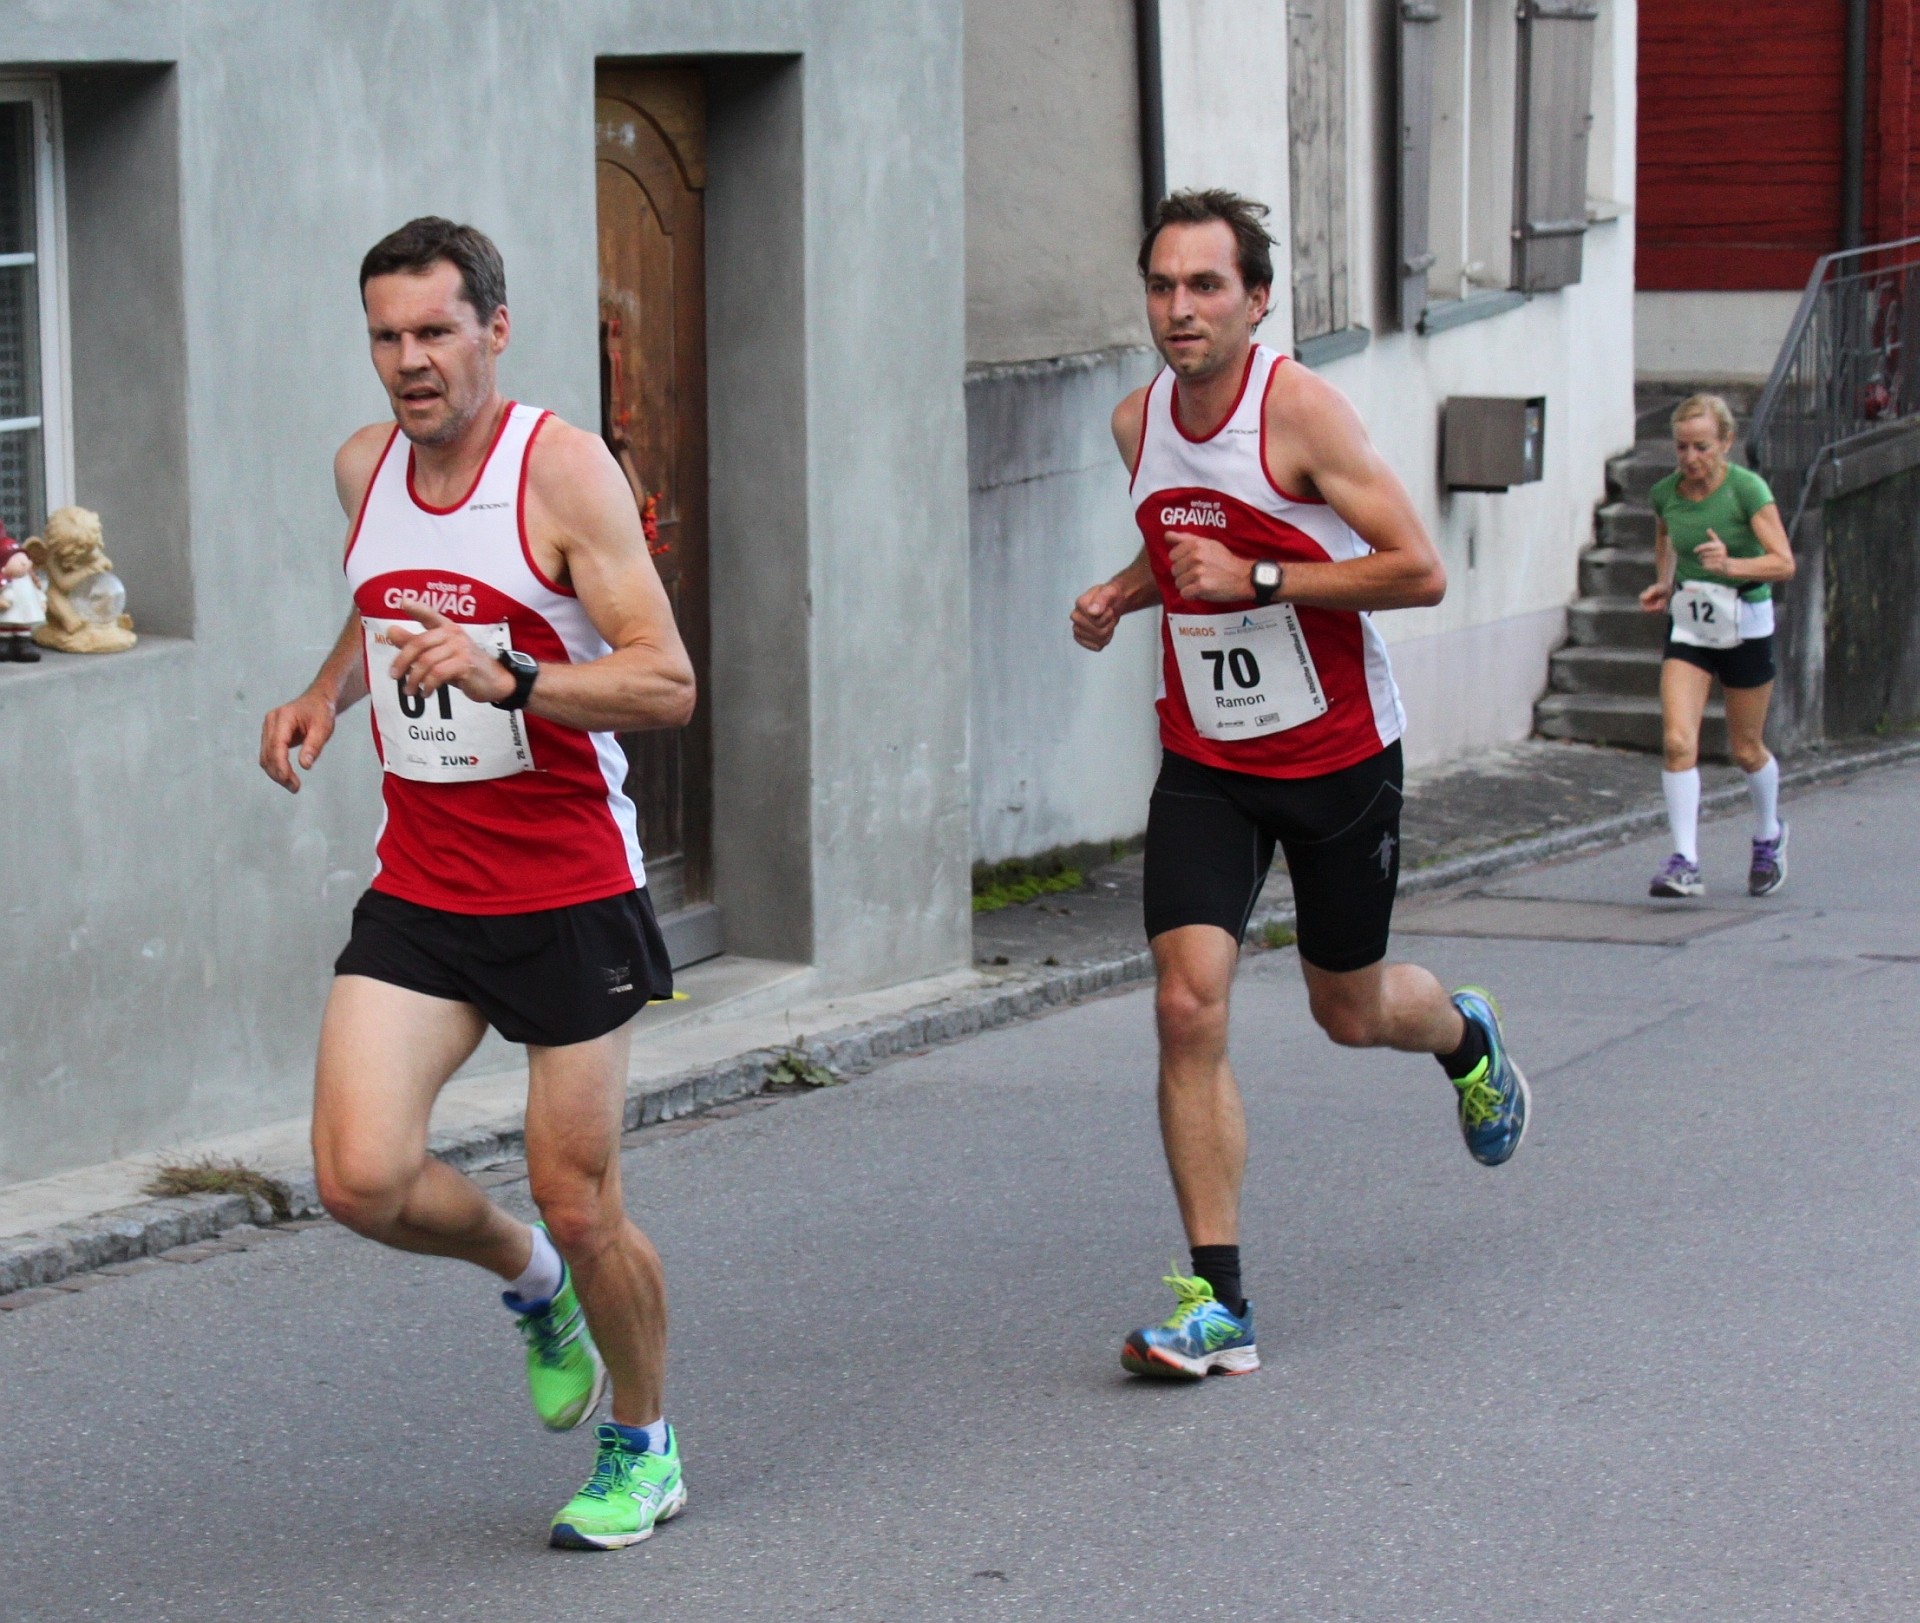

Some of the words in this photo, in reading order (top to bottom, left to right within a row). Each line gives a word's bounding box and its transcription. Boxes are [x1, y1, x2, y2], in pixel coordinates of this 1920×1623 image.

[1160, 507, 1226, 528] GRAVAG
[1688, 600, 1715, 624] 12
[1178, 626, 1216, 637] MIGROS
[1200, 647, 1261, 691] 70
[1215, 693, 1266, 709] Ramon
[408, 725, 457, 742] Guido
